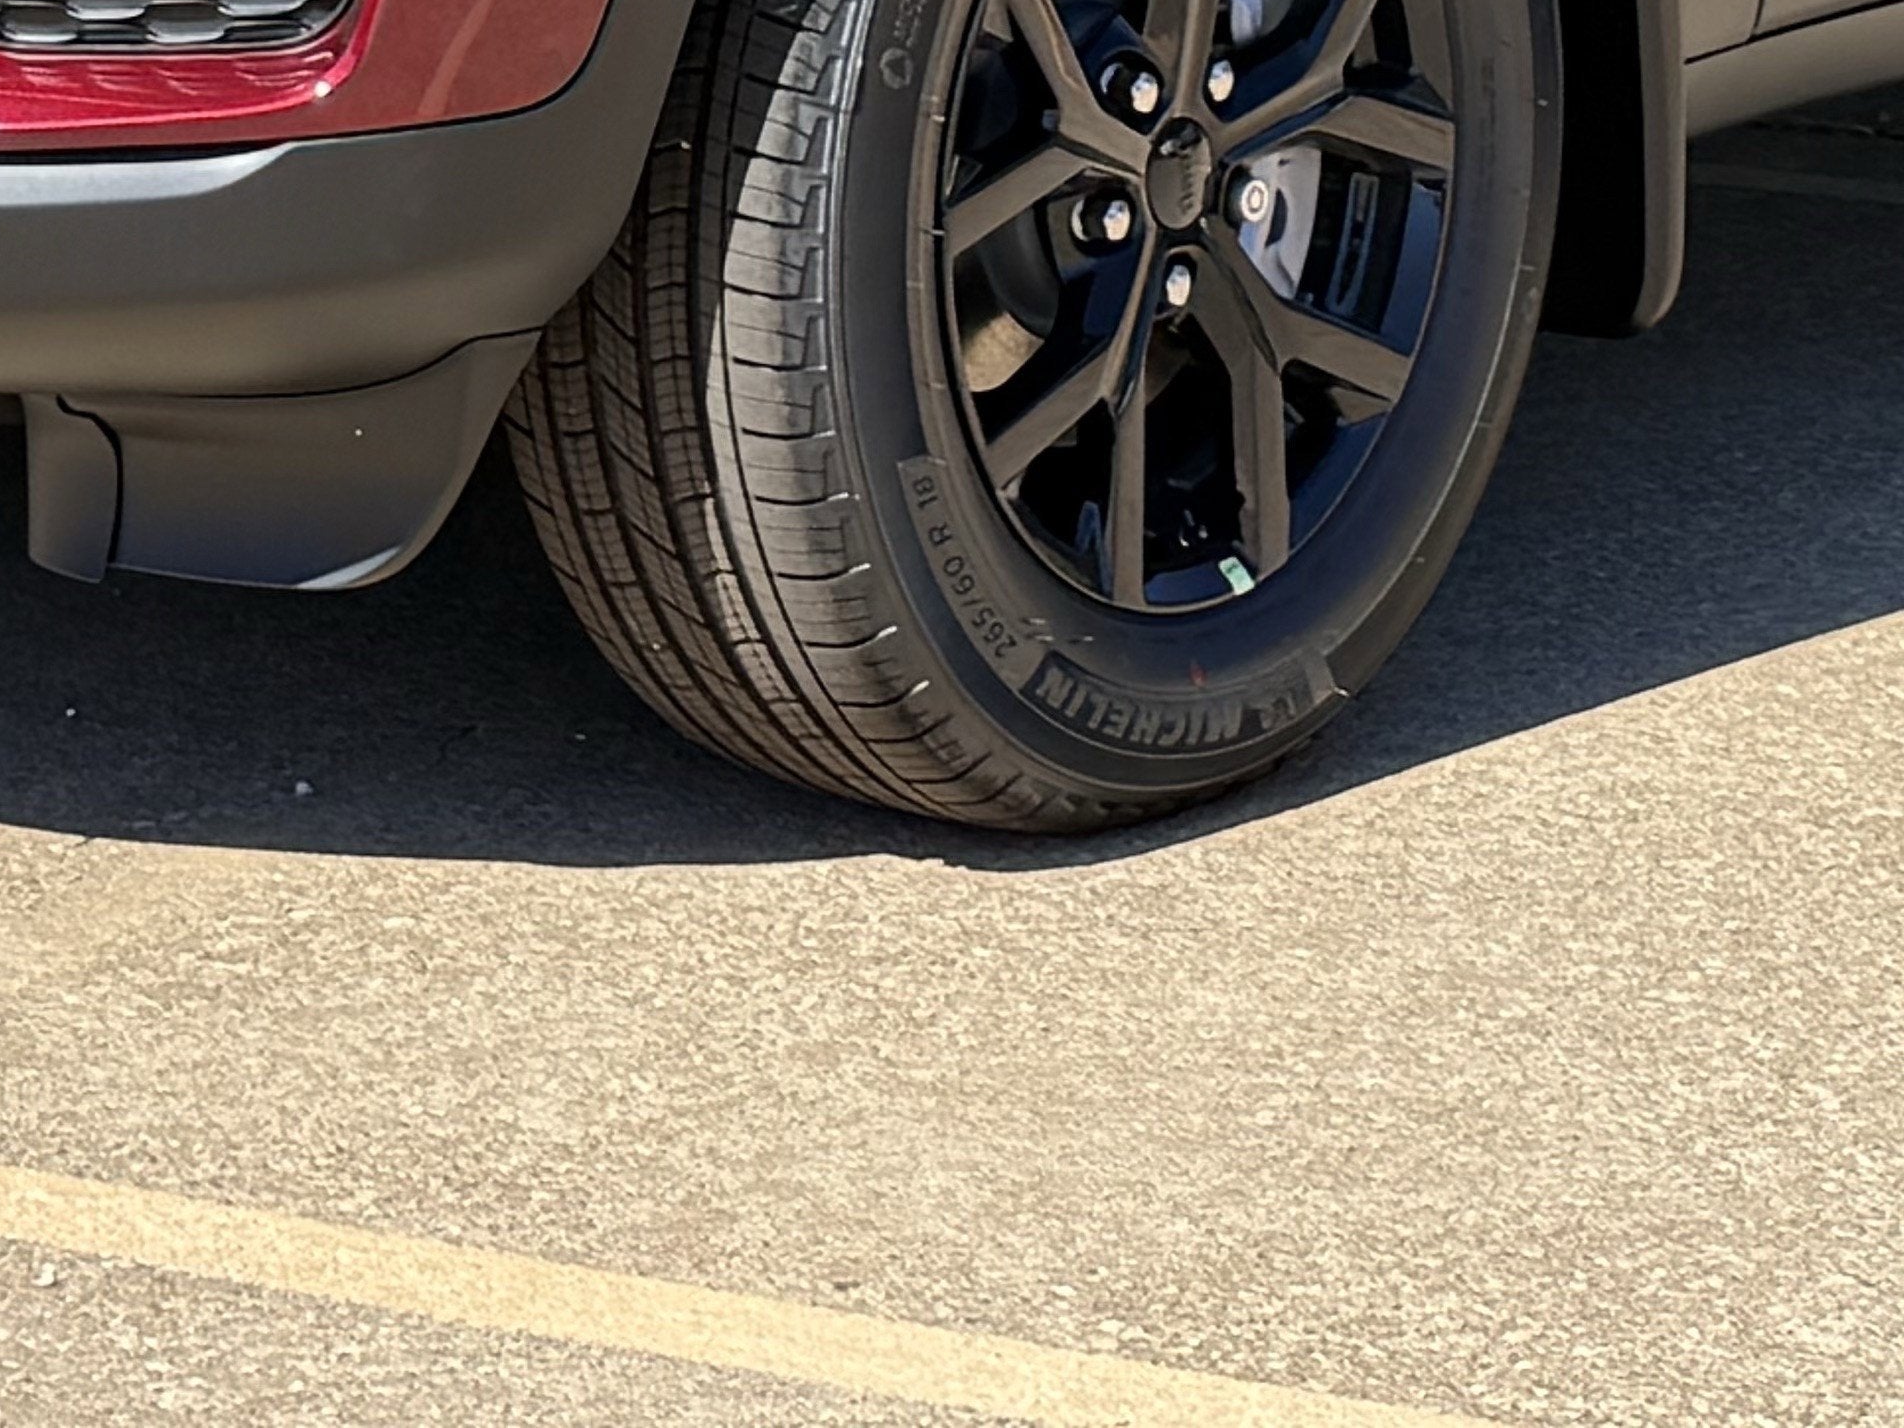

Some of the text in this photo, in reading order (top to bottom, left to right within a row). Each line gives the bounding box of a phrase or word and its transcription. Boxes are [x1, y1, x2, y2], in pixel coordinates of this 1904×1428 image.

[910, 475, 1018, 659] 265/60 R 18
[1034, 664, 1244, 746] MICHELIN
